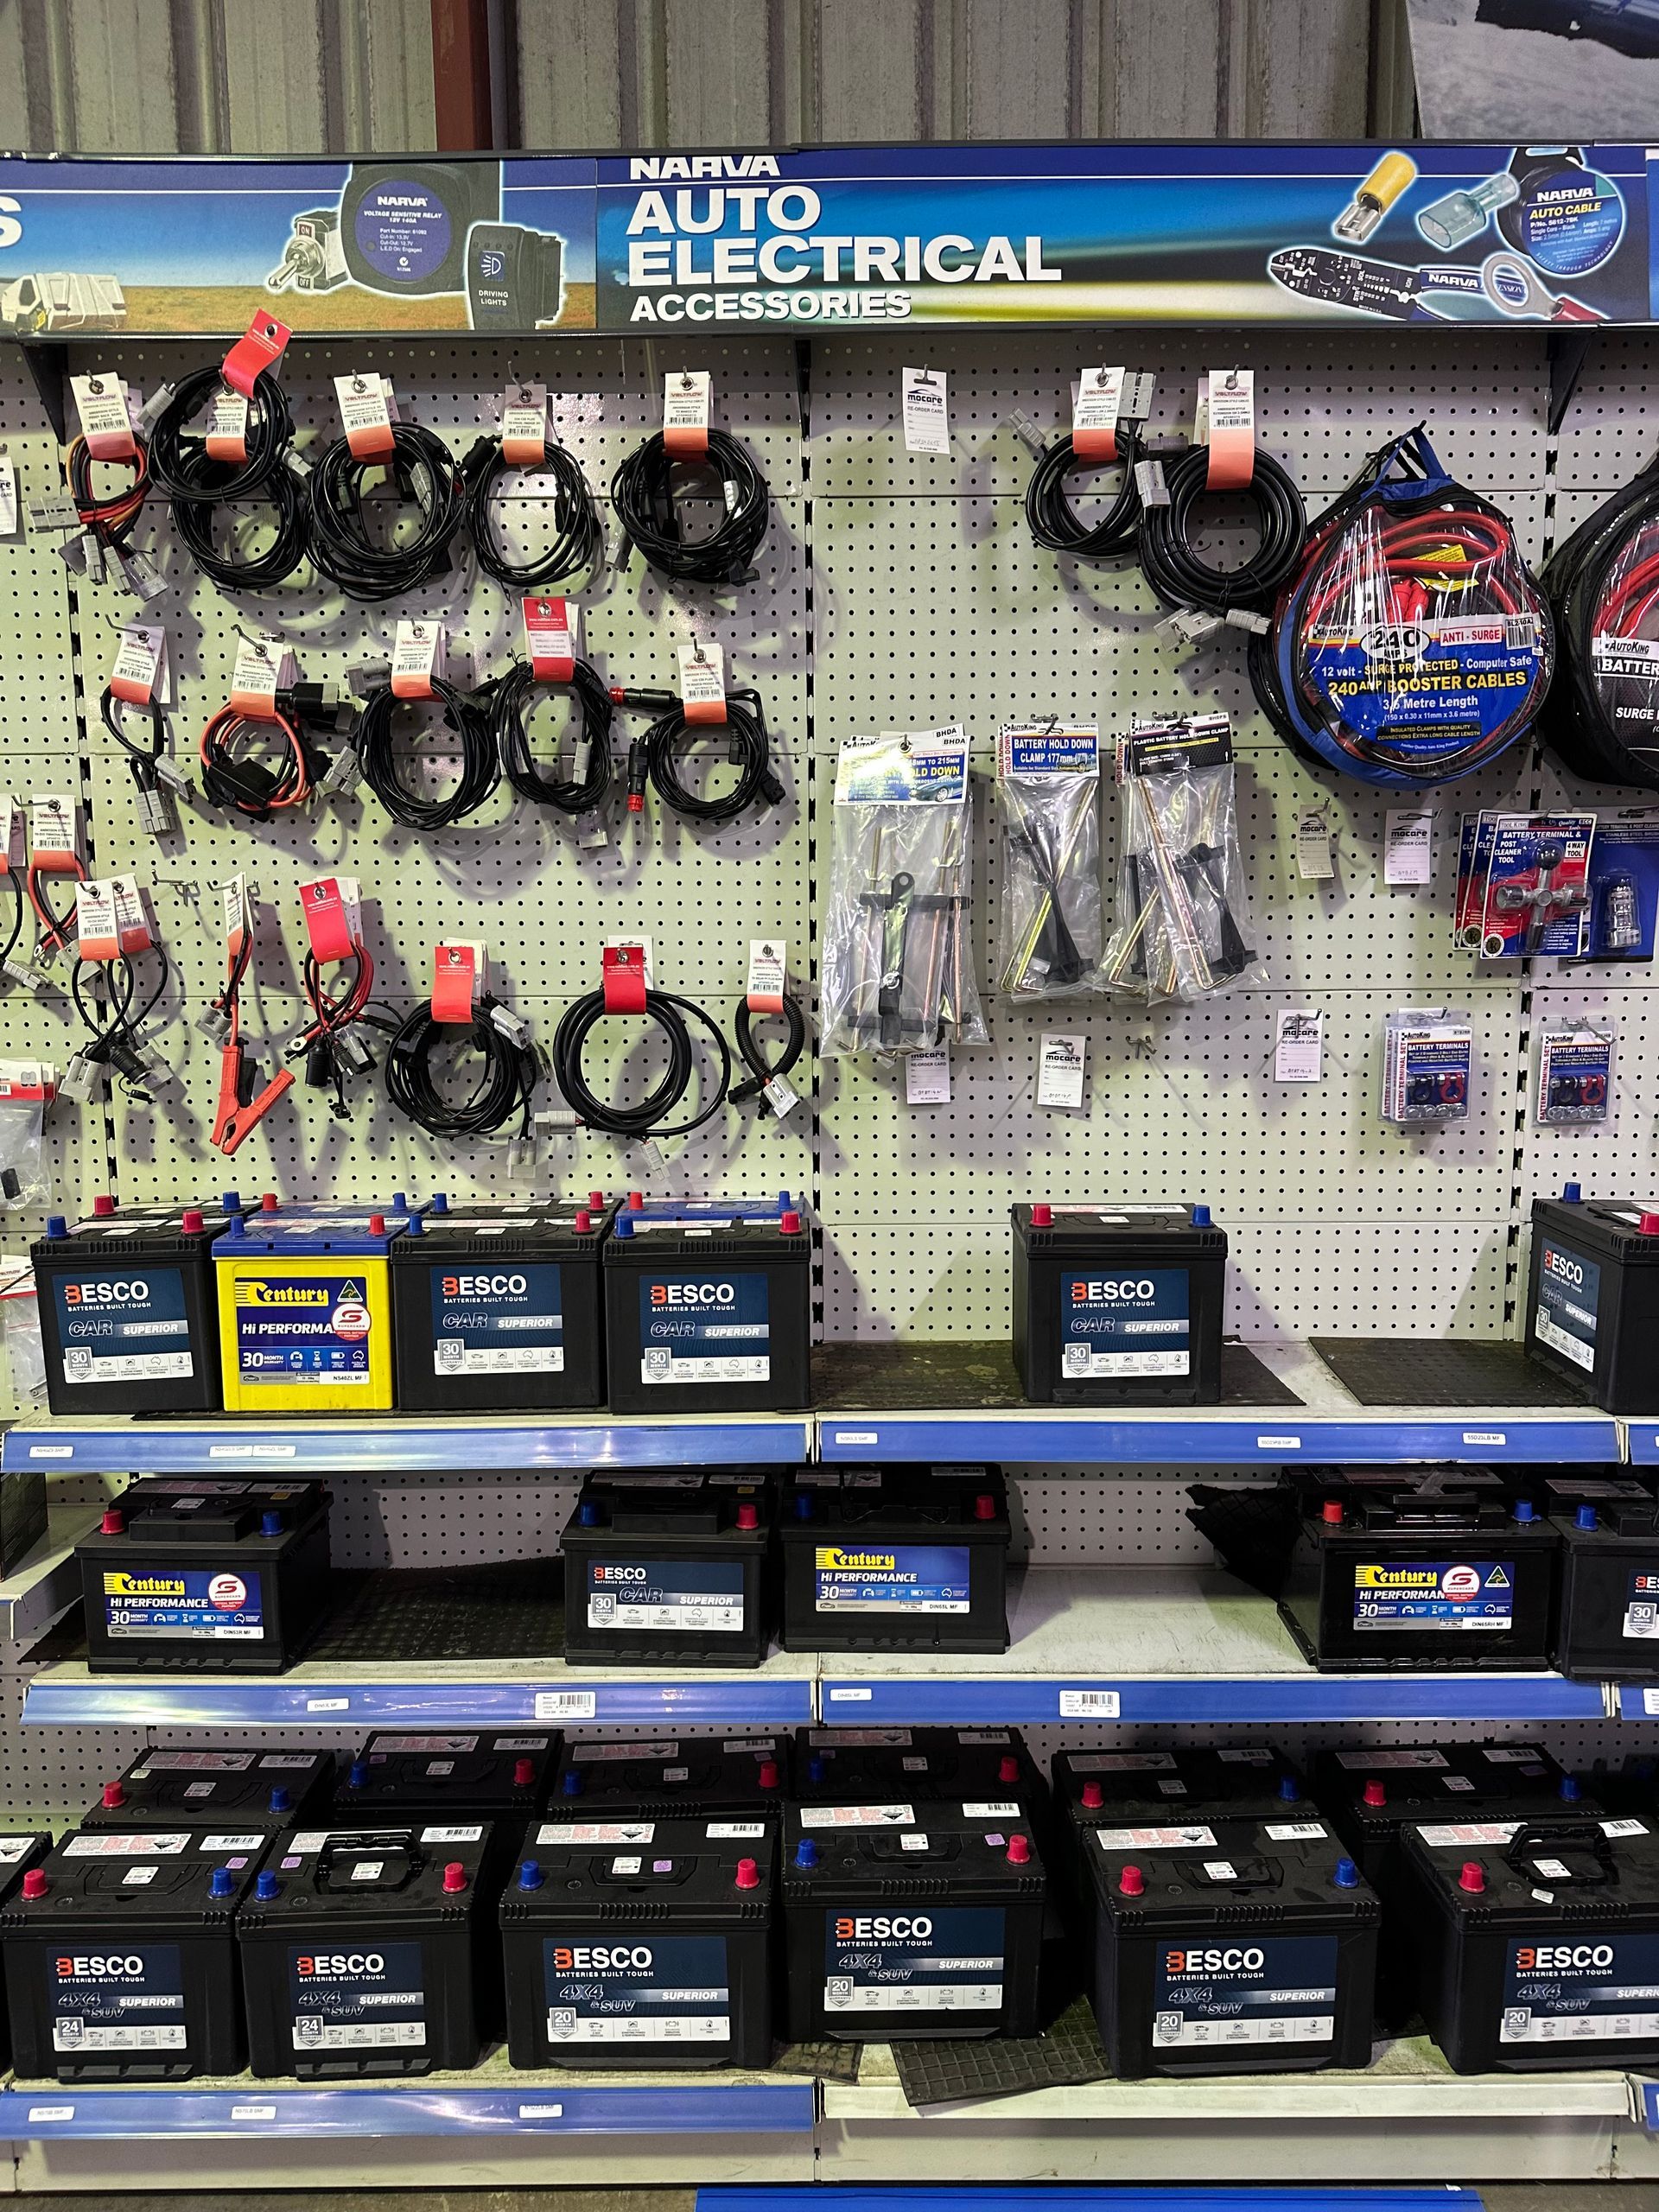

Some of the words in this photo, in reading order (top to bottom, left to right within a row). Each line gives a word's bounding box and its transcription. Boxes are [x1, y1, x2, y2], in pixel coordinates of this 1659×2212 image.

[629, 156, 781, 181] NARVA
[378, 197, 427, 207] NARVA
[1537, 188, 1593, 202] NARVA
[626, 185, 821, 234] AUTO
[1529, 207, 1563, 219] AUTO
[1565, 202, 1602, 215] CABLE
[301, 226, 309, 235] ON
[628, 234, 1062, 287] ELECTRICAL
[300, 278, 308, 287] OFF
[1427, 273, 1479, 289] NARVA
[629, 289, 911, 322] ACCESSORIES
[907, 394, 943, 404] mocare
[1370, 629, 1421, 649] 240
[1443, 632, 1464, 644] ANTI
[1472, 630, 1500, 640] SURGE
[1321, 666, 1334, 677] 12
[1338, 665, 1356, 677] volt
[1364, 663, 1395, 675] SURGE
[1466, 657, 1508, 670] Computer
[1510, 656, 1532, 667] Safe
[1602, 658, 1659, 675] BATTER
[1328, 681, 1357, 696] 240
[1388, 675, 1461, 694] BOOSTER
[1466, 671, 1526, 689] CABLES
[1403, 697, 1436, 708] Metre
[1440, 695, 1478, 709] Length
[1616, 707, 1654, 719] SURGE
[936, 728, 957, 737] BHDA
[1014, 739, 1046, 749] BATTERY
[1049, 739, 1069, 749] HOLD
[1071, 739, 1093, 749] DOWN
[1134, 737, 1154, 746] PLASTIC
[1020, 753, 1046, 763] CLAMP
[1047, 753, 1073, 763] 177mm
[931, 766, 960, 776] DOWN
[1545, 1249, 1583, 1285] BESCO
[442, 1274, 527, 1296] BESCO
[1071, 1280, 1154, 1300] BESCO
[64, 1281, 149, 1304] BESCO
[235, 1282, 328, 1306] Century
[650, 1284, 734, 1305] BESCO
[442, 1313, 487, 1329] CAR
[1565, 1303, 1592, 1325] SUPERIOR
[69, 1319, 113, 1337] CAR
[123, 1324, 179, 1335] SUPERIOR
[242, 1324, 256, 1334] Hi
[498, 1319, 553, 1328] SUPERIOR
[651, 1321, 695, 1338] CAR
[1071, 1317, 1116, 1333] CAR
[1125, 1323, 1179, 1332] SUPERIOR
[705, 1327, 760, 1337] SUPERIOR
[442, 1344, 459, 1355] 30
[71, 1351, 86, 1363] 30
[242, 1352, 264, 1367] 30
[816, 1548, 894, 1570] Century
[594, 1567, 646, 1580] BESCO
[821, 1573, 832, 1582] Hi
[835, 1573, 918, 1582] PERFORMANCE
[1356, 1565, 1437, 1587] Century
[104, 1573, 185, 1595] Century
[111, 1598, 122, 1607] Hi
[124, 1599, 208, 1608] PERFORMANCE
[595, 1598, 611, 1609] 30
[680, 1596, 734, 1605] SUPERIOR
[836, 1916, 932, 1939] BESCO
[553, 1947, 652, 1969] BESCO
[839, 1954, 882, 1969] 4X4
[1166, 1948, 1264, 1973] BESCO
[1516, 1945, 1614, 1969] BESCO
[56, 1955, 143, 1976] BESCO
[297, 1955, 384, 1975] BESCO
[939, 1961, 993, 1969] SUPERIOR
[560, 1984, 604, 2000] 4X4
[662, 1992, 718, 2000] SUPERIOR
[1270, 1992, 1325, 2001] SUPERIOR
[119, 1998, 175, 2006] SUPERIOR
[359, 1994, 416, 2005] SUPERIOR
[601, 1999, 636, 2012] SUV
[555, 2012, 571, 2023] 20
[61, 2022, 79, 2033] 24
